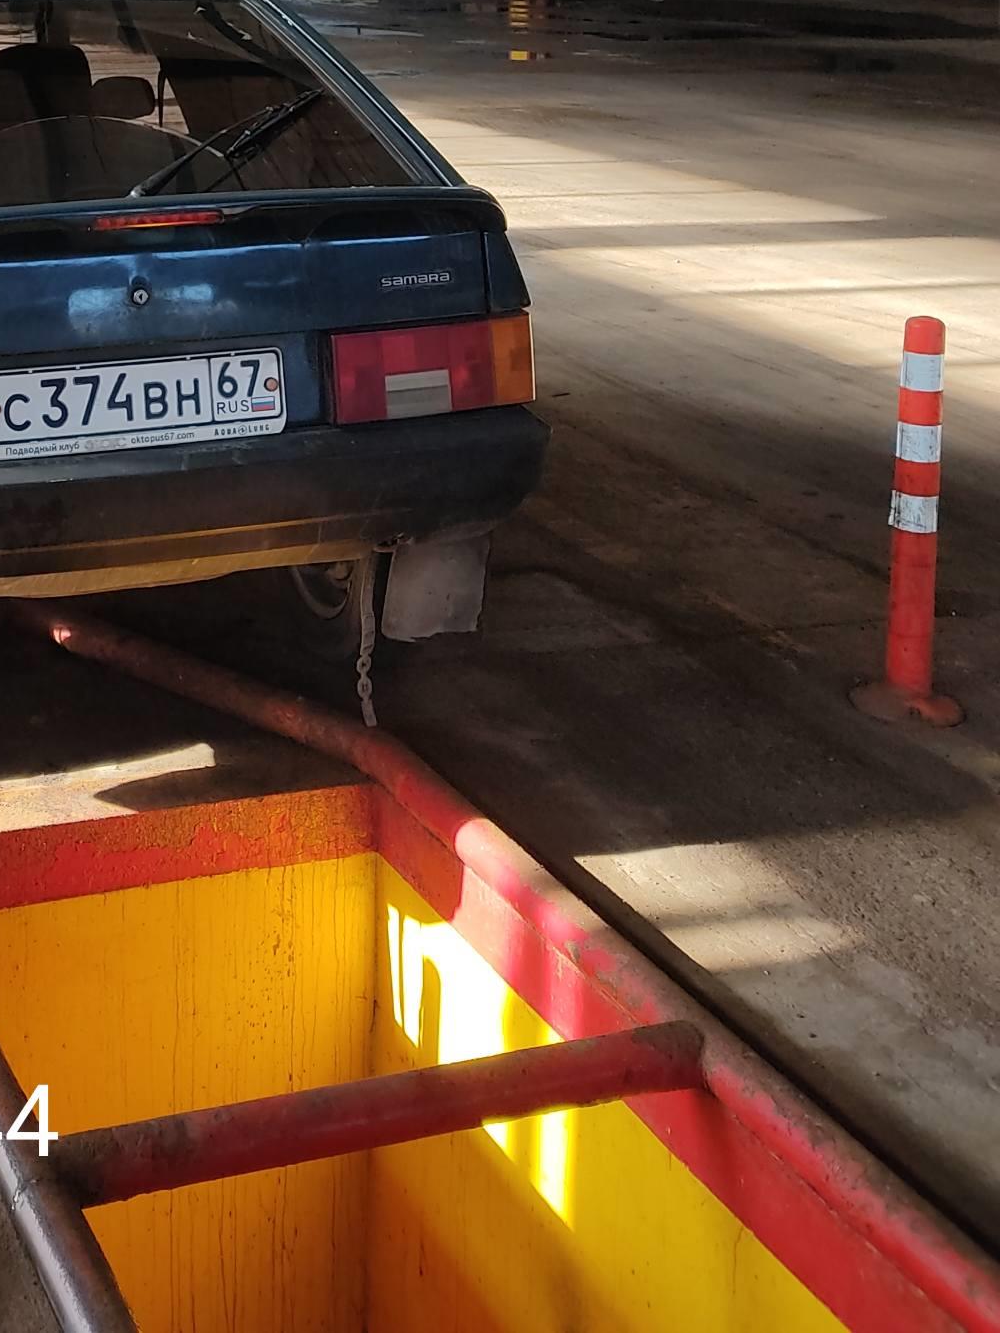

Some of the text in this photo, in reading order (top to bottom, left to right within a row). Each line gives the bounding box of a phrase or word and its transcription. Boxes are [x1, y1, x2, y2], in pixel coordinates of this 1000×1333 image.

[217, 359, 260, 398] 67
[217, 400, 249, 414] RUS
[214, 424, 270, 436] AQUA LUNG
[5, 443, 57, 456] Подводный
[59, 441, 80, 453] клуб
[130, 431, 195, 444] oktopus67.com
